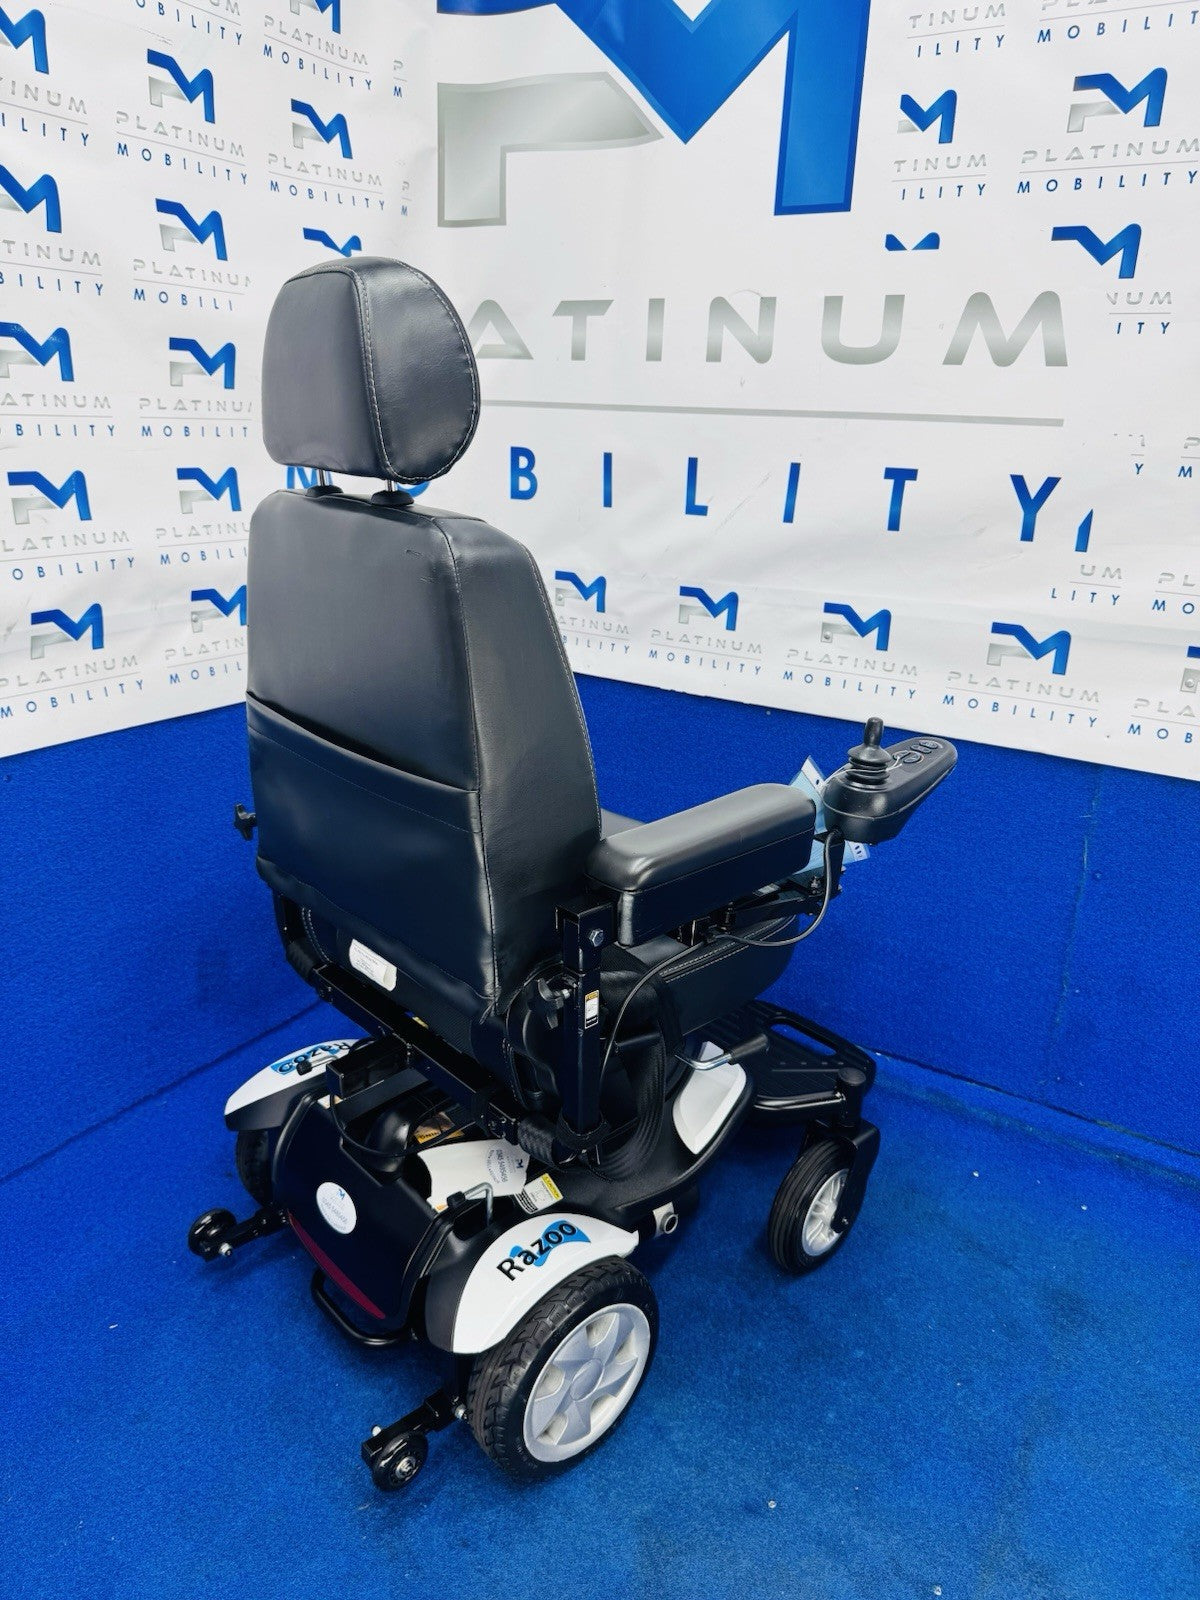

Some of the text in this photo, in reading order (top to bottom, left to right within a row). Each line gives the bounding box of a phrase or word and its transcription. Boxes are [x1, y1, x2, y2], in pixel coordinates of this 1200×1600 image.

[263, 14, 368, 66] PLATINUM
[263, 44, 373, 91] MOBILITY
[116, 111, 246, 157] PLATINUM
[117, 142, 248, 185] MOBILITY
[1021, 138, 1200, 164] PLATINUM
[268, 152, 383, 187] PLATINUM
[1017, 171, 1197, 194] MOBILITY
[269, 180, 385, 212] MOBILITY
[650, 629, 763, 654] PLATINUM
[648, 649, 762, 676] MOBILITY
[786, 648, 918, 677] PLATINUM
[782, 670, 917, 699] MOBILITY
[947, 670, 1100, 703] PLATINUM
[942, 694, 1098, 728] MOBILITY
[496, 1222, 578, 1282] Razoo
